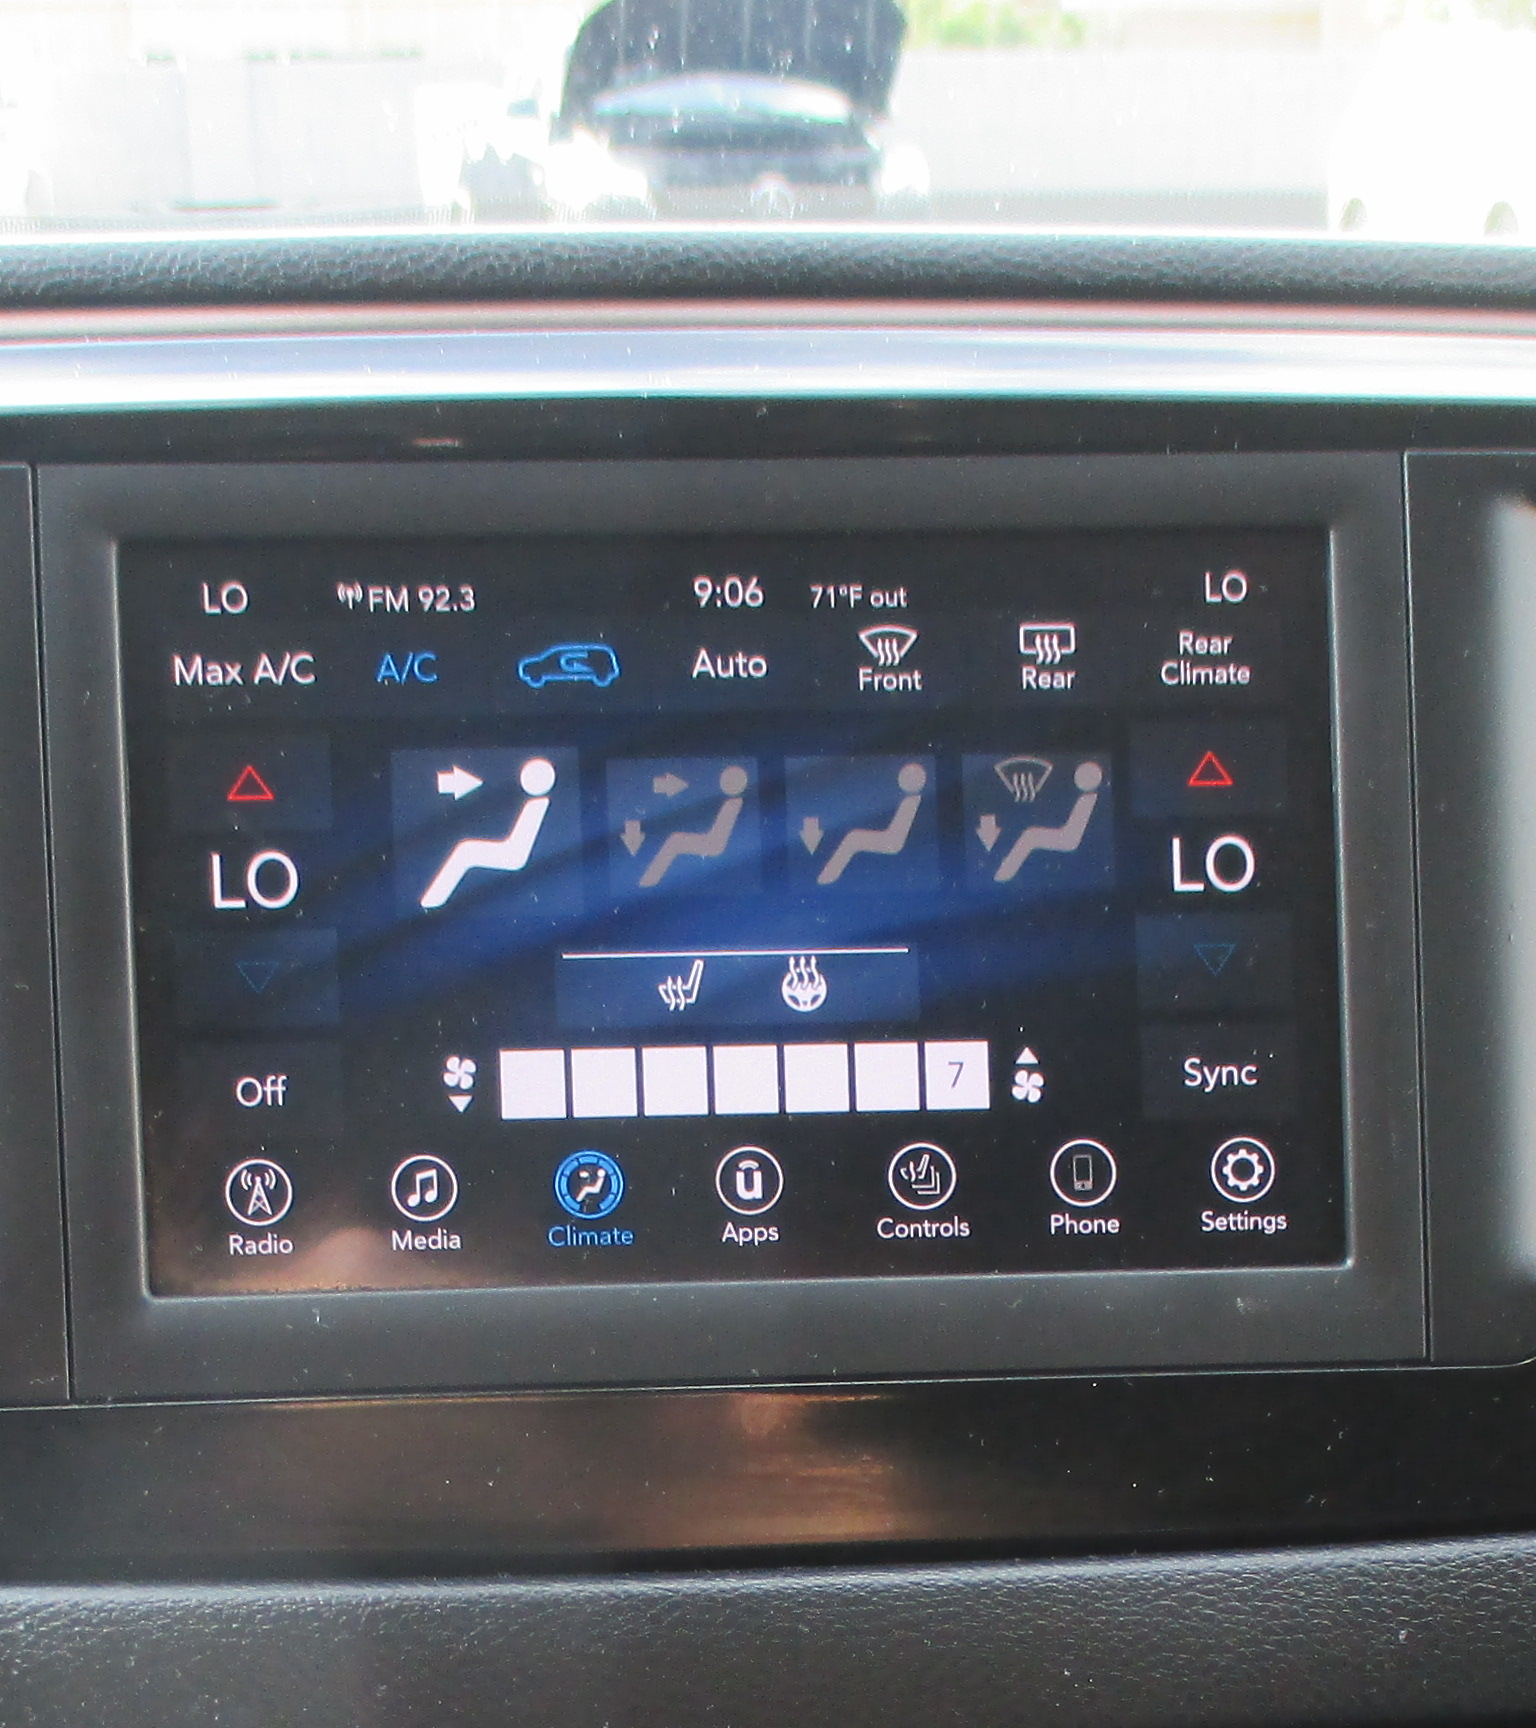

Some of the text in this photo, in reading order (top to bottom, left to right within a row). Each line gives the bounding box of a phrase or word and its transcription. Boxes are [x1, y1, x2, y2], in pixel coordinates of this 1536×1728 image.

[202, 581, 248, 614] LO
[367, 584, 475, 613] FM 92.3
[693, 575, 764, 608] 9:06
[870, 586, 907, 608] out
[1205, 569, 1248, 603] LO
[1179, 630, 1233, 655] Rear
[173, 651, 316, 686] Max A/C
[376, 651, 438, 685] A/C
[692, 647, 767, 679] Auto
[1022, 664, 1076, 690] Rear
[1160, 659, 1251, 686] Climate
[858, 666, 922, 692] Front
[1171, 833, 1255, 893] LO
[211, 849, 299, 909] LO
[946, 1059, 966, 1091] 7
[1183, 1056, 1258, 1093] Sync
[235, 1074, 288, 1108] Off
[548, 1224, 634, 1247] Climate
[721, 1221, 779, 1247] Apps
[876, 1215, 970, 1239] Controls
[1050, 1212, 1120, 1235] Phone
[1201, 1209, 1288, 1235] Settings
[229, 1231, 294, 1256] Radio
[391, 1227, 462, 1251] Media
